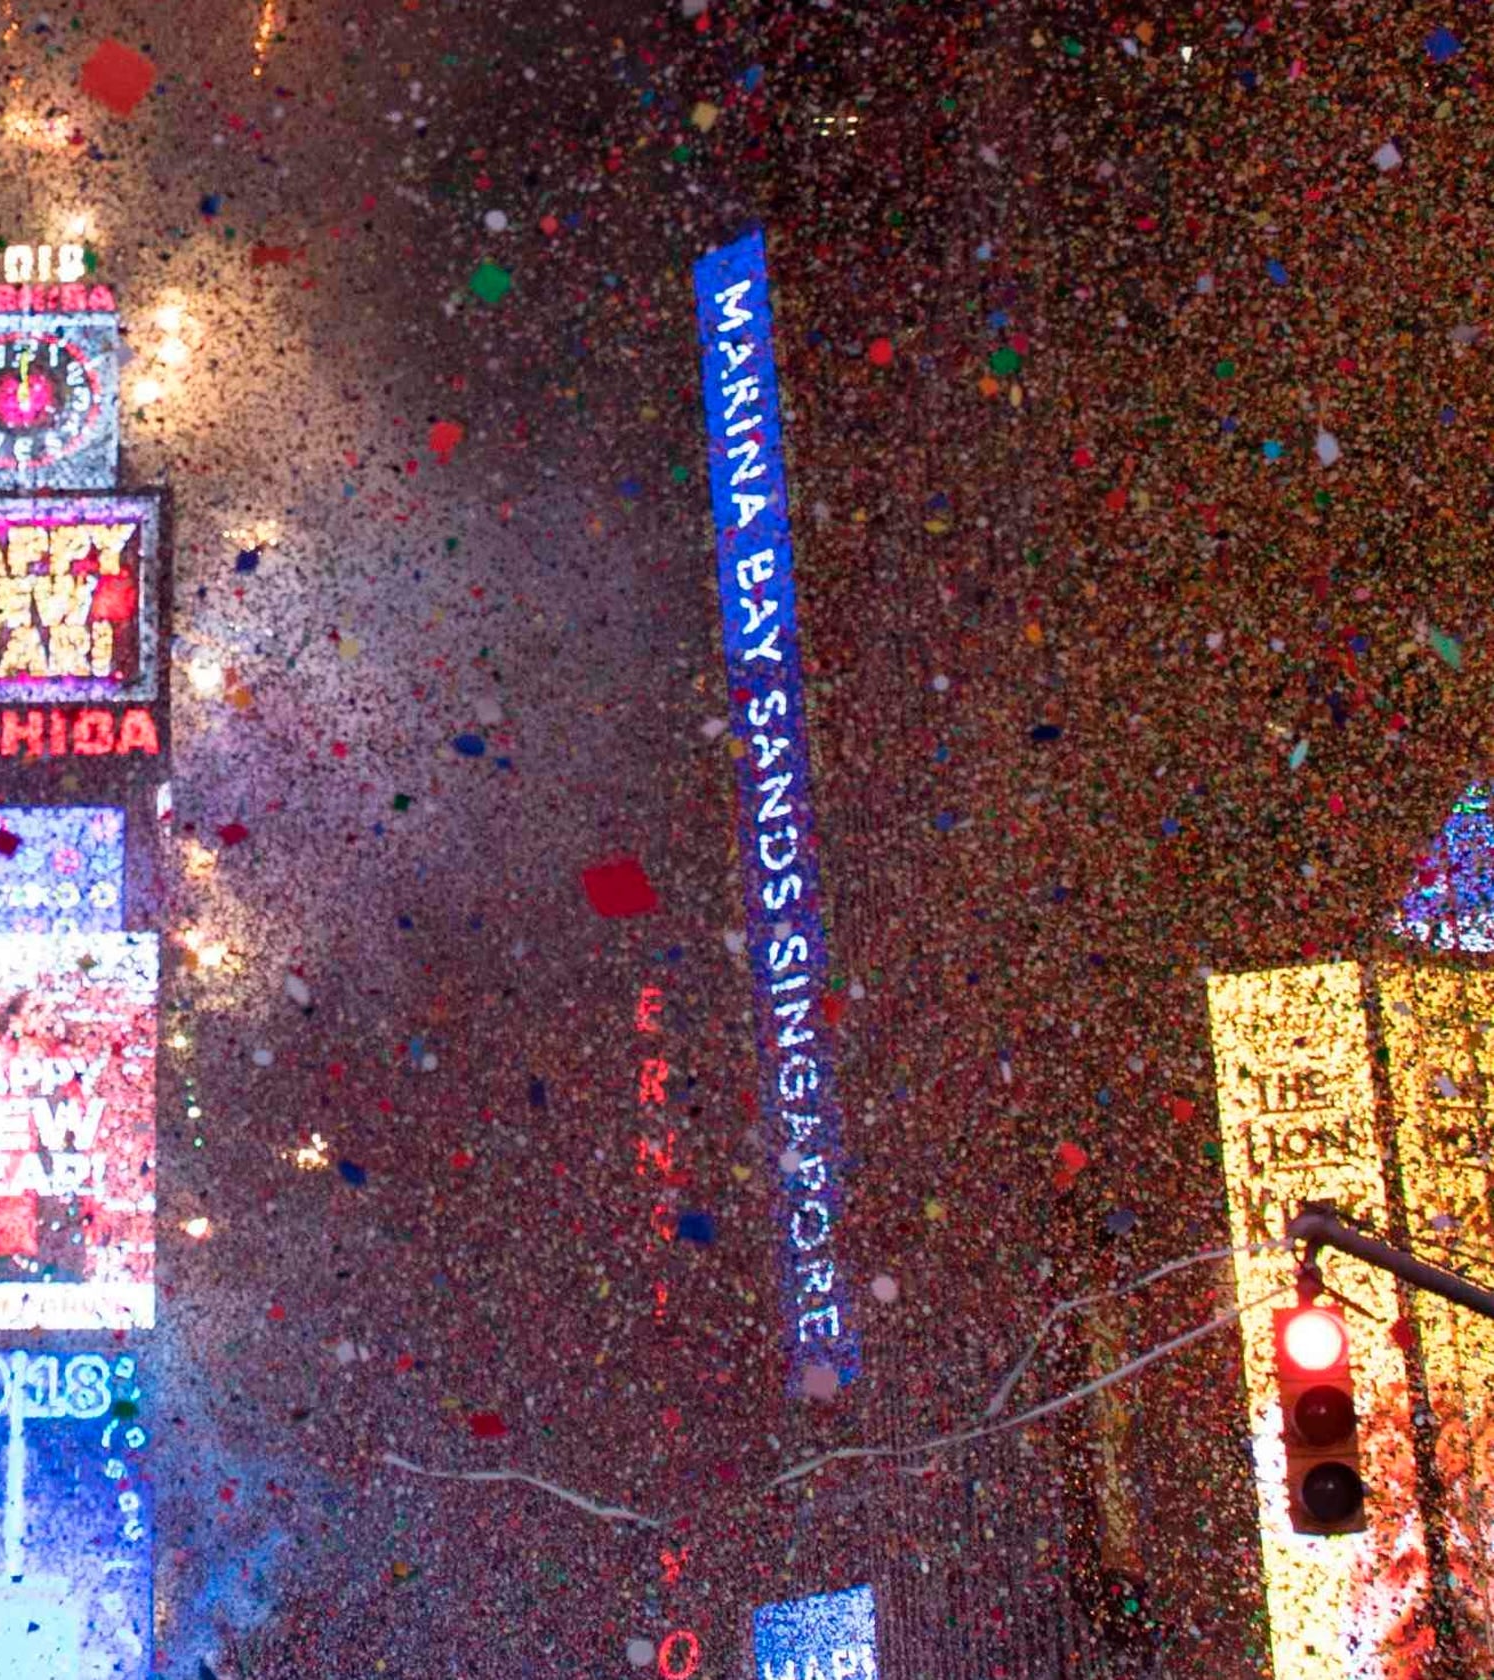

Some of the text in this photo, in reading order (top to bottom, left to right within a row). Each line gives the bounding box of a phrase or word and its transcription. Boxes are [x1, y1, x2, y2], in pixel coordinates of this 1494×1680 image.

[714, 279, 840, 1342] MARINA BAY SANDS SINGAPORE
